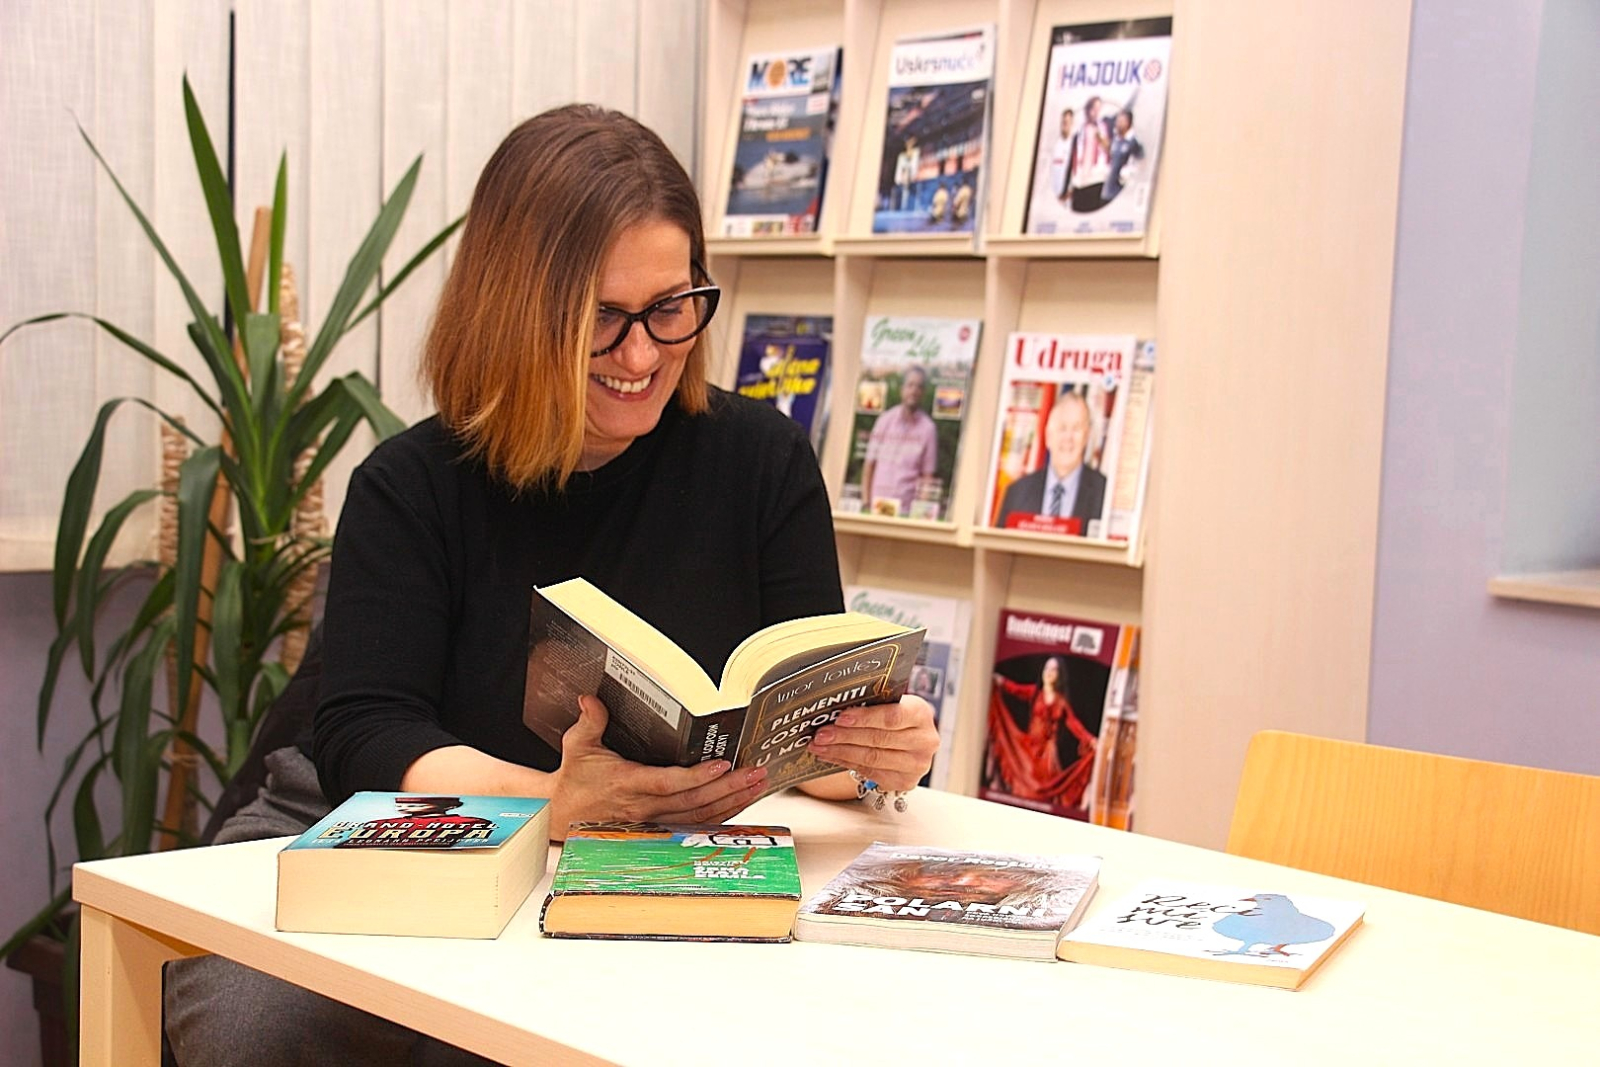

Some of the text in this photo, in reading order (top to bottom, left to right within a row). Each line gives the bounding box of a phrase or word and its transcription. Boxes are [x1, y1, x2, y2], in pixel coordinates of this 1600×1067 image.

[871, 317, 916, 348] Green
[1015, 338, 1122, 375] Udruga
[771, 685, 867, 732] PLEMENITI
[760, 702, 866, 751] GOSPOD
[317, 827, 494, 839] EUROPA
[831, 903, 931, 917] SAN
[842, 893, 1047, 917] POLARNI
